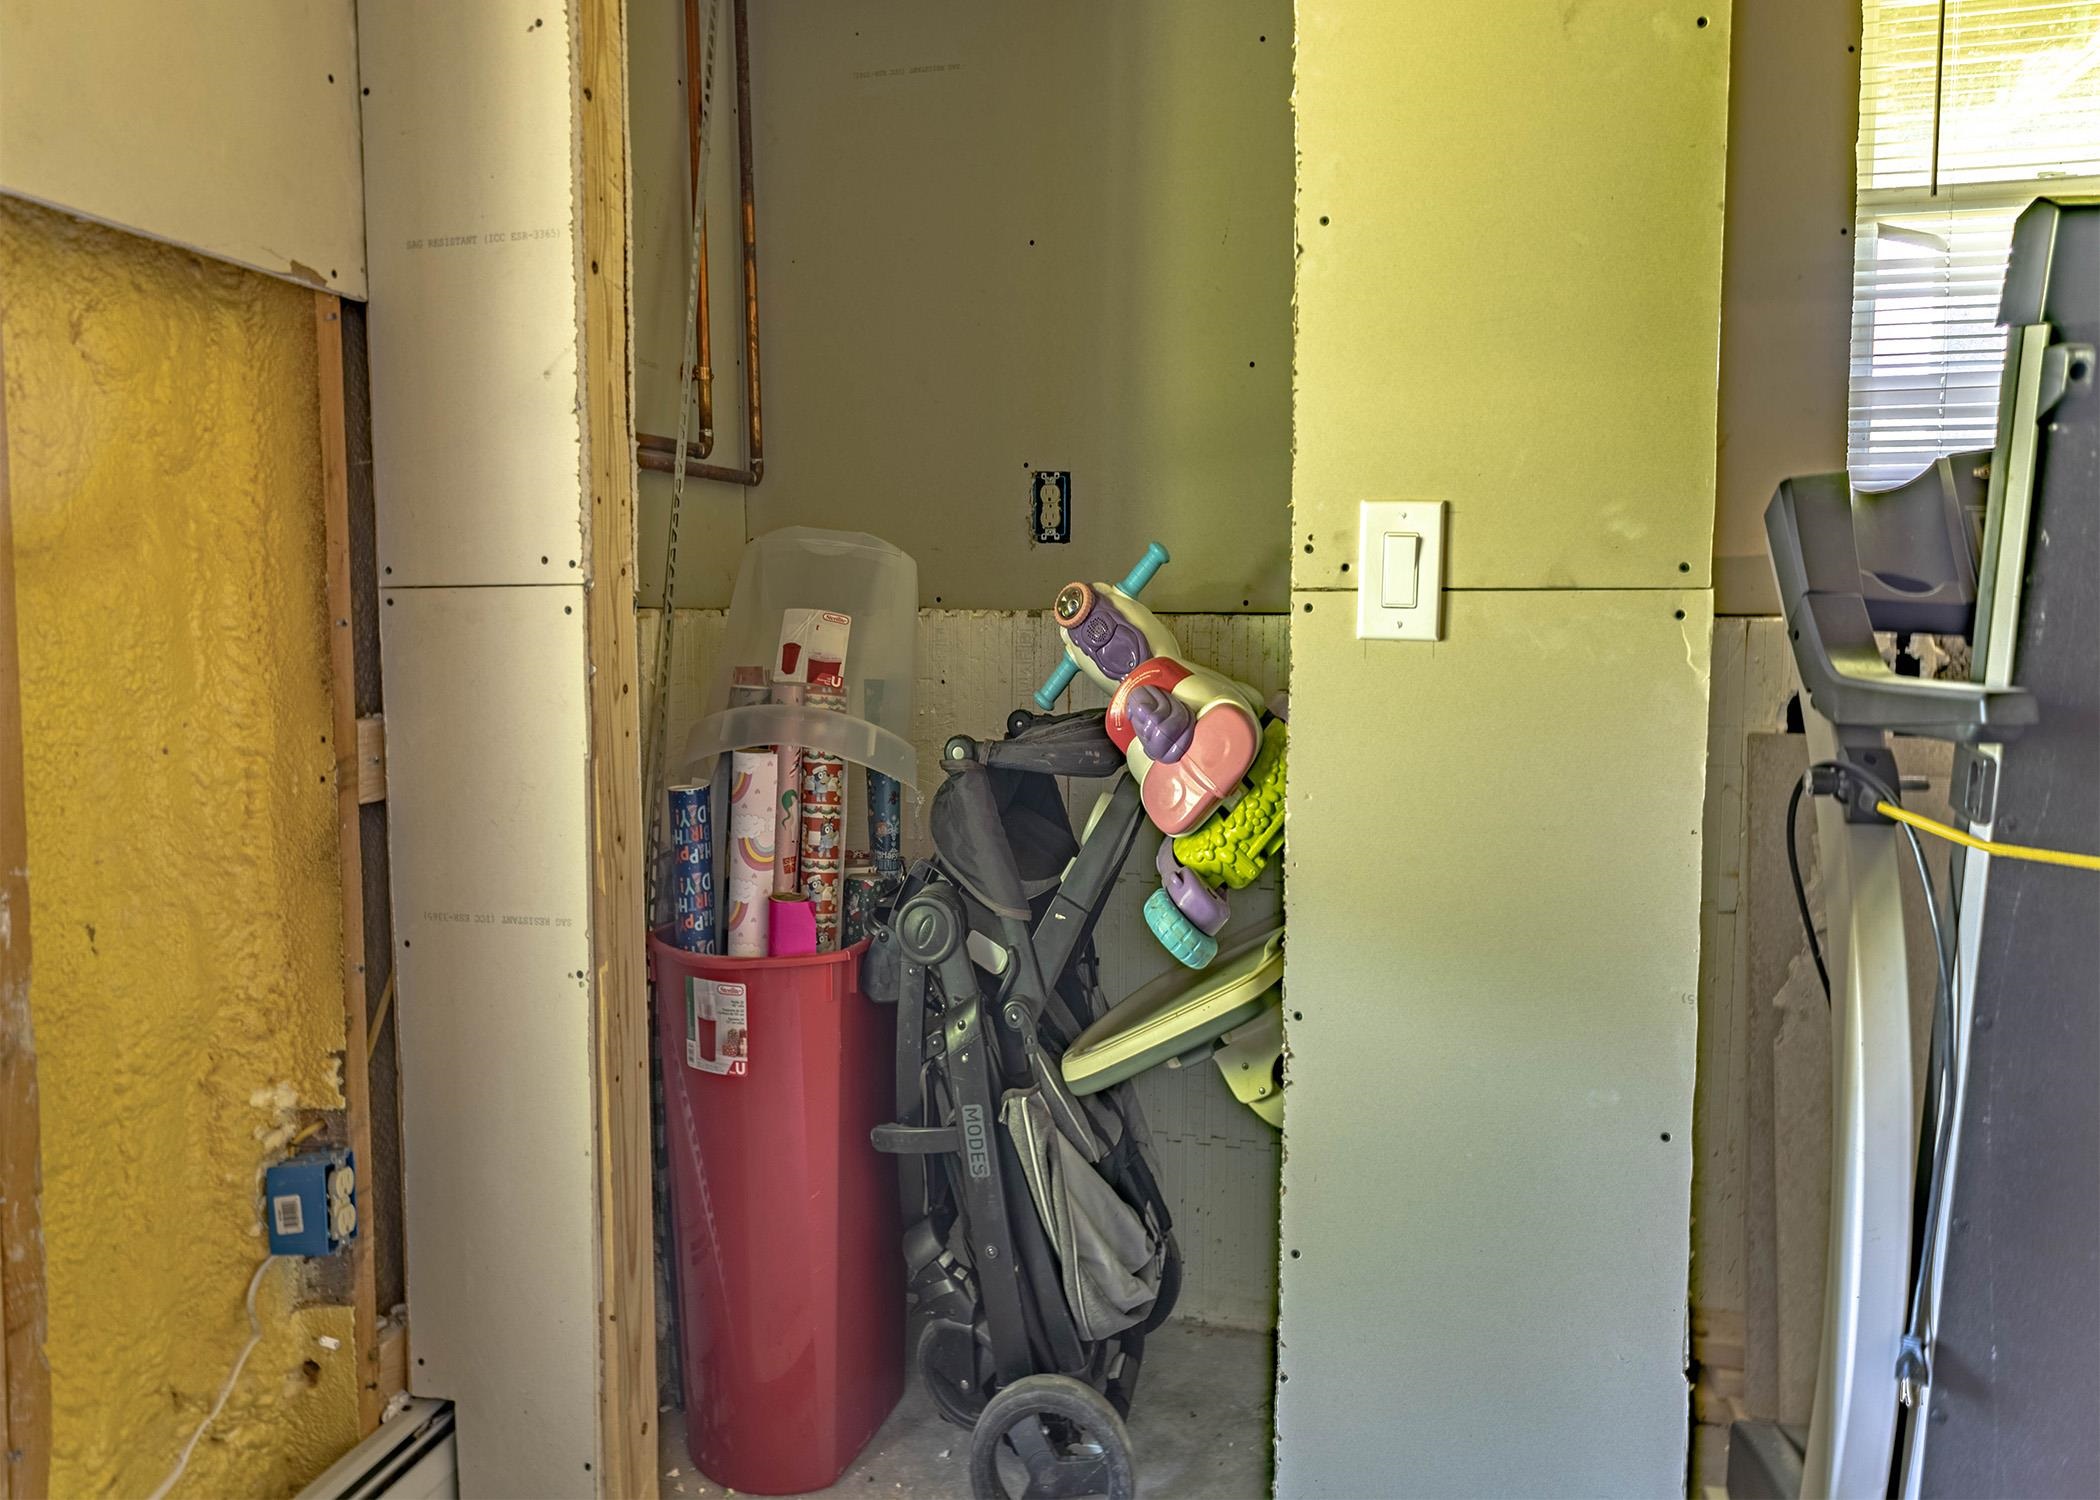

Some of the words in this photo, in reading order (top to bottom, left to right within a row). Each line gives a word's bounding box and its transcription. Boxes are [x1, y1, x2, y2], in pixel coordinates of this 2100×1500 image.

[406, 239, 424, 250] SAG
[428, 235, 478, 248] RESISTANT
[484, 232, 506, 245] (ICC
[674, 842, 712, 865] HAPPY
[502, 915, 551, 926] RESISTANT
[556, 917, 573, 927] SAG
[964, 1108, 986, 1175] MODES
